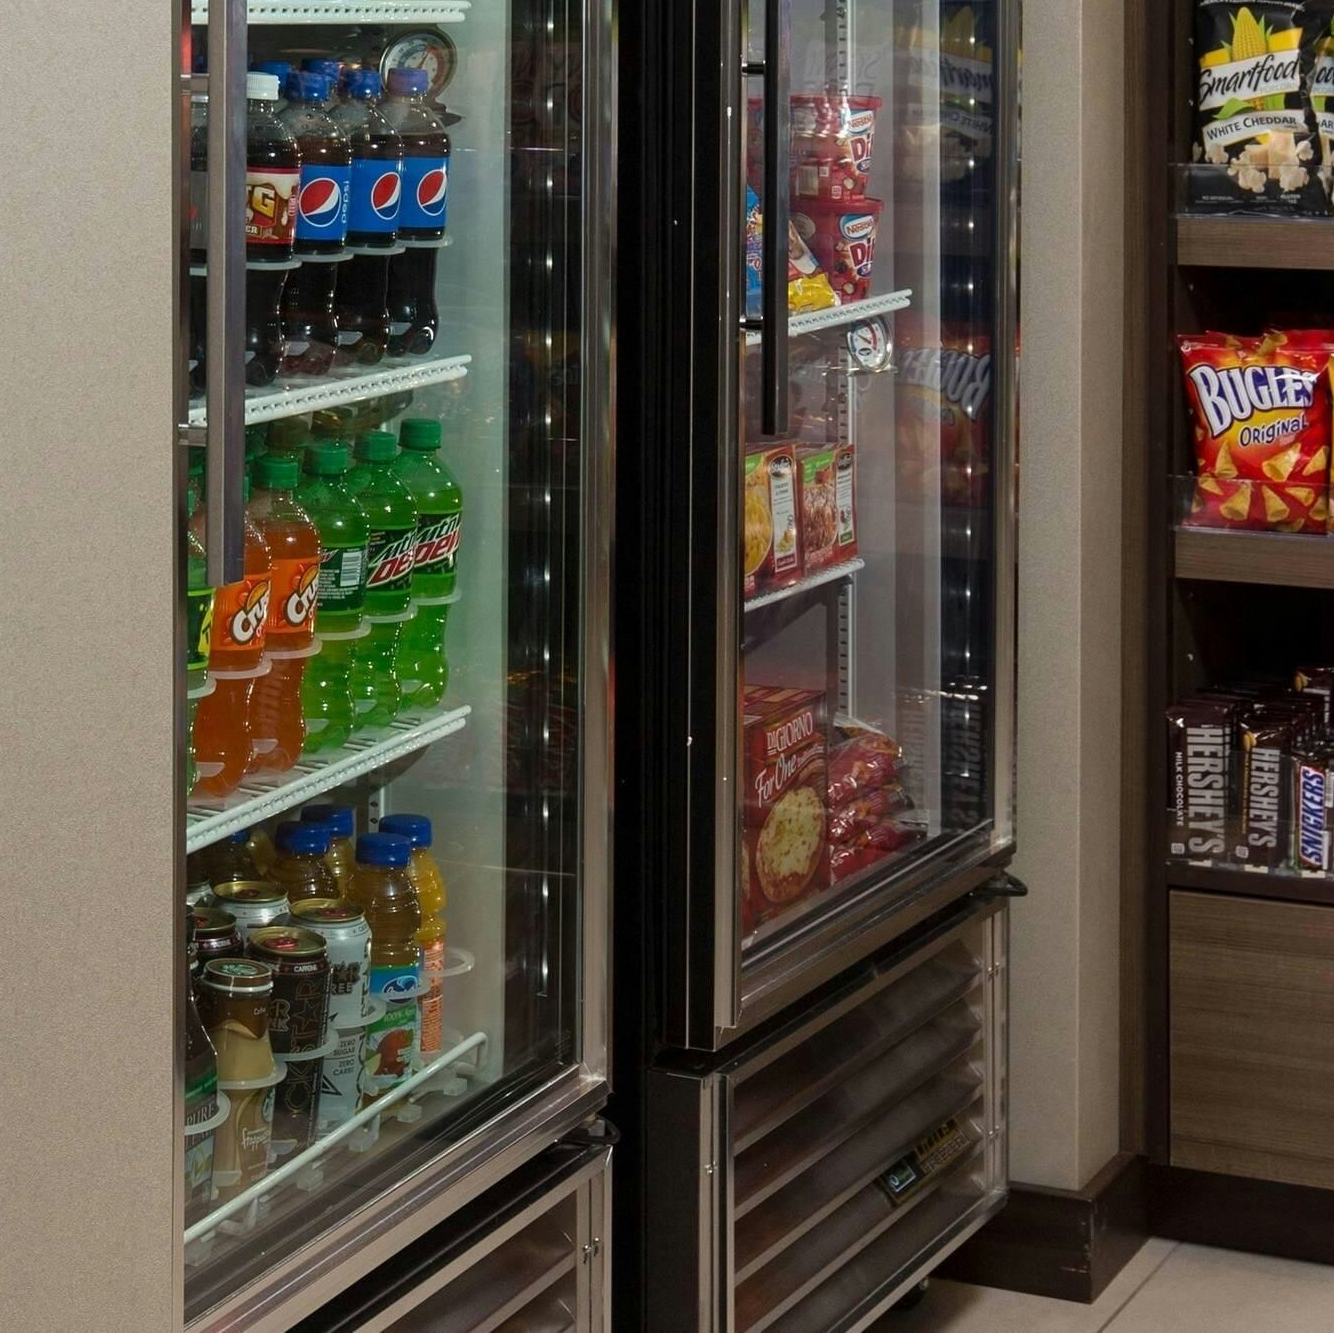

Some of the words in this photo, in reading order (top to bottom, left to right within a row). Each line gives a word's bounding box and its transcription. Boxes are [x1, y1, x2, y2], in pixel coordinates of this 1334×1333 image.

[1199, 54, 1300, 105] Smartfood
[1207, 121, 1241, 141] WHITE
[1243, 116, 1297, 130] CHEDDAR
[341, 180, 350, 224] pepsi
[1189, 365, 1317, 437] BUGLES
[1175, 752, 1183, 772] MILK
[1175, 775, 1184, 827] CHOCOLATE
[1187, 727, 1225, 853] HERSHEY'S
[1248, 747, 1281, 848] HERSHEY'S
[1301, 767, 1325, 864] SNICKERS
